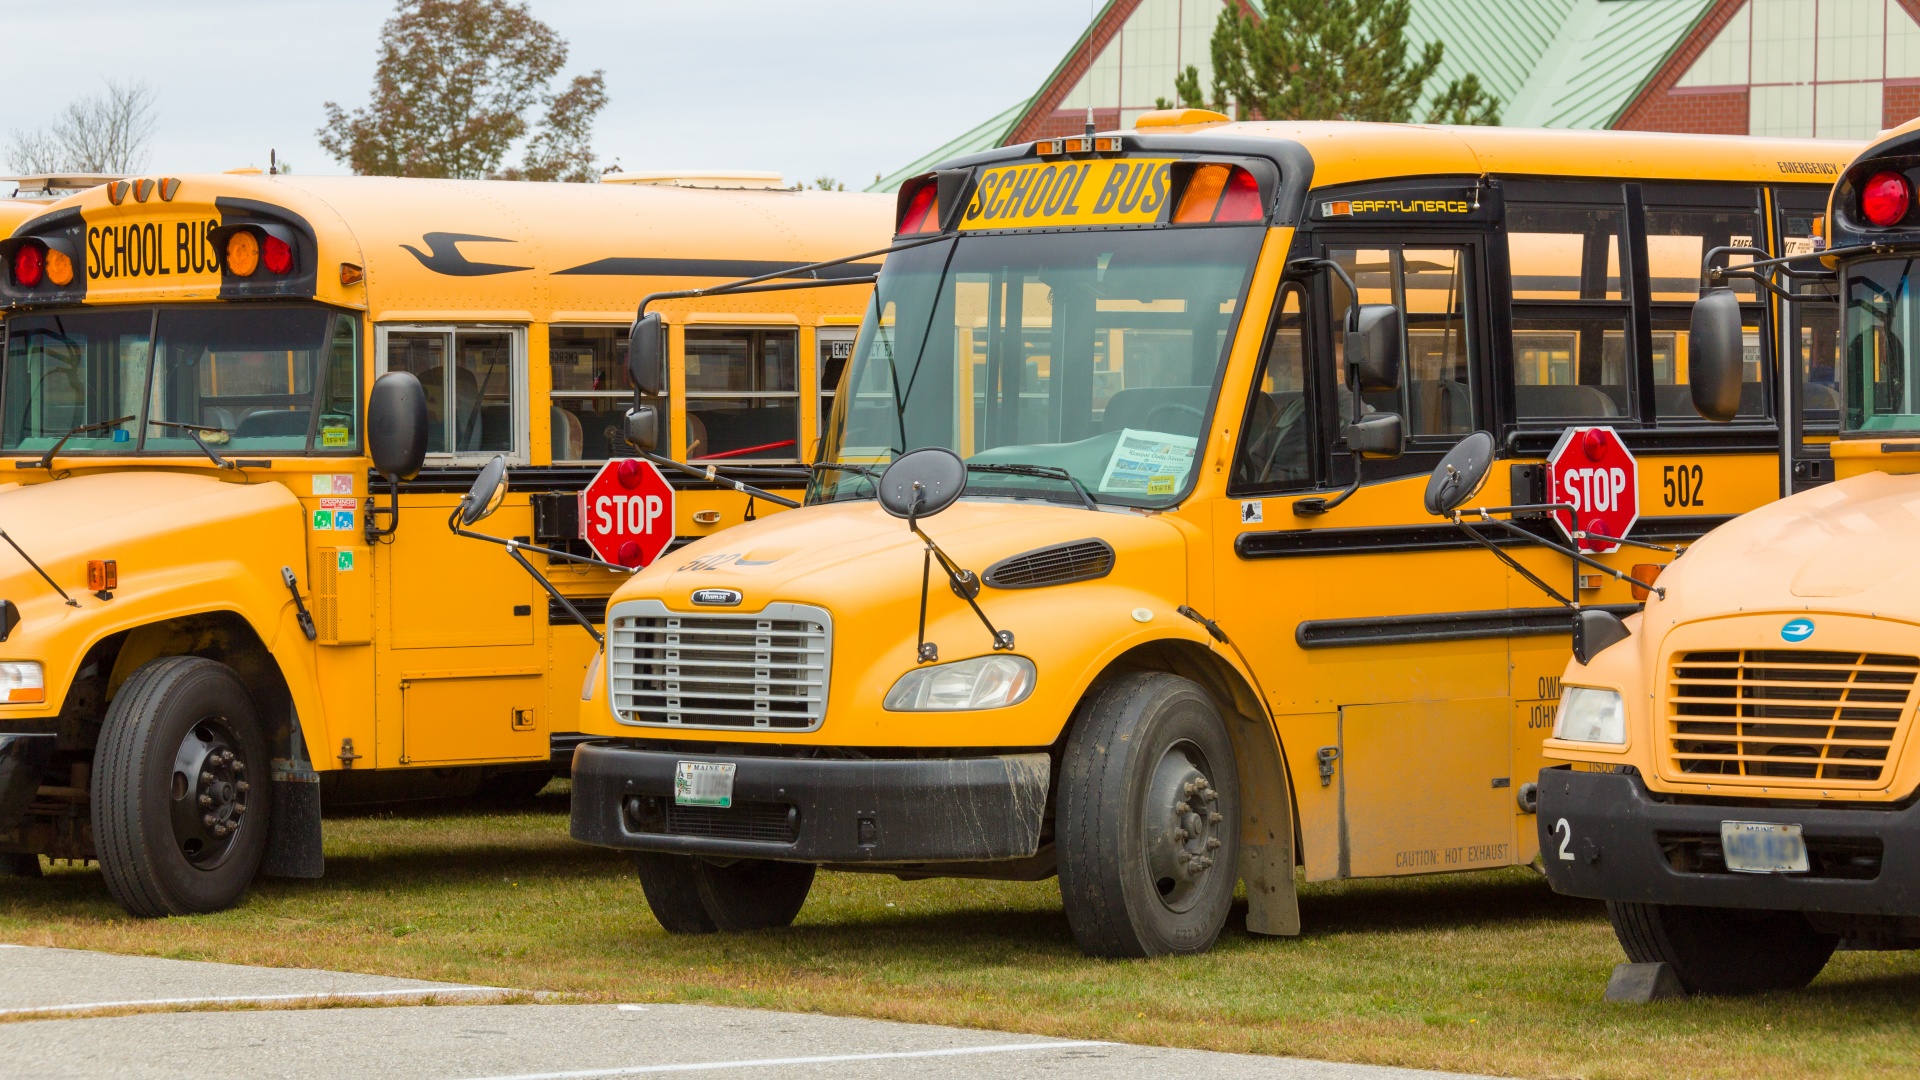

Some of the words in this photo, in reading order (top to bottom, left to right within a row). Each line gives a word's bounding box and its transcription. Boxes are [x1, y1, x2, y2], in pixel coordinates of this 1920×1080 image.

[1777, 162, 1838, 174] EMERGENCY
[966, 164, 1091, 221] SCHOOL
[1092, 162, 1172, 214] BUS
[88, 223, 170, 279] SCHOOL
[177, 219, 220, 274] BUS
[1564, 467, 1626, 512] STOP
[1664, 465, 1704, 507] 502
[595, 495, 663, 535] STOP
[677, 554, 741, 571] 502
[1396, 850, 1439, 867] CAUTION:
[1445, 848, 1463, 863] HOT
[1469, 844, 1508, 861] EXHAUST
[1556, 818, 1575, 860] 2
